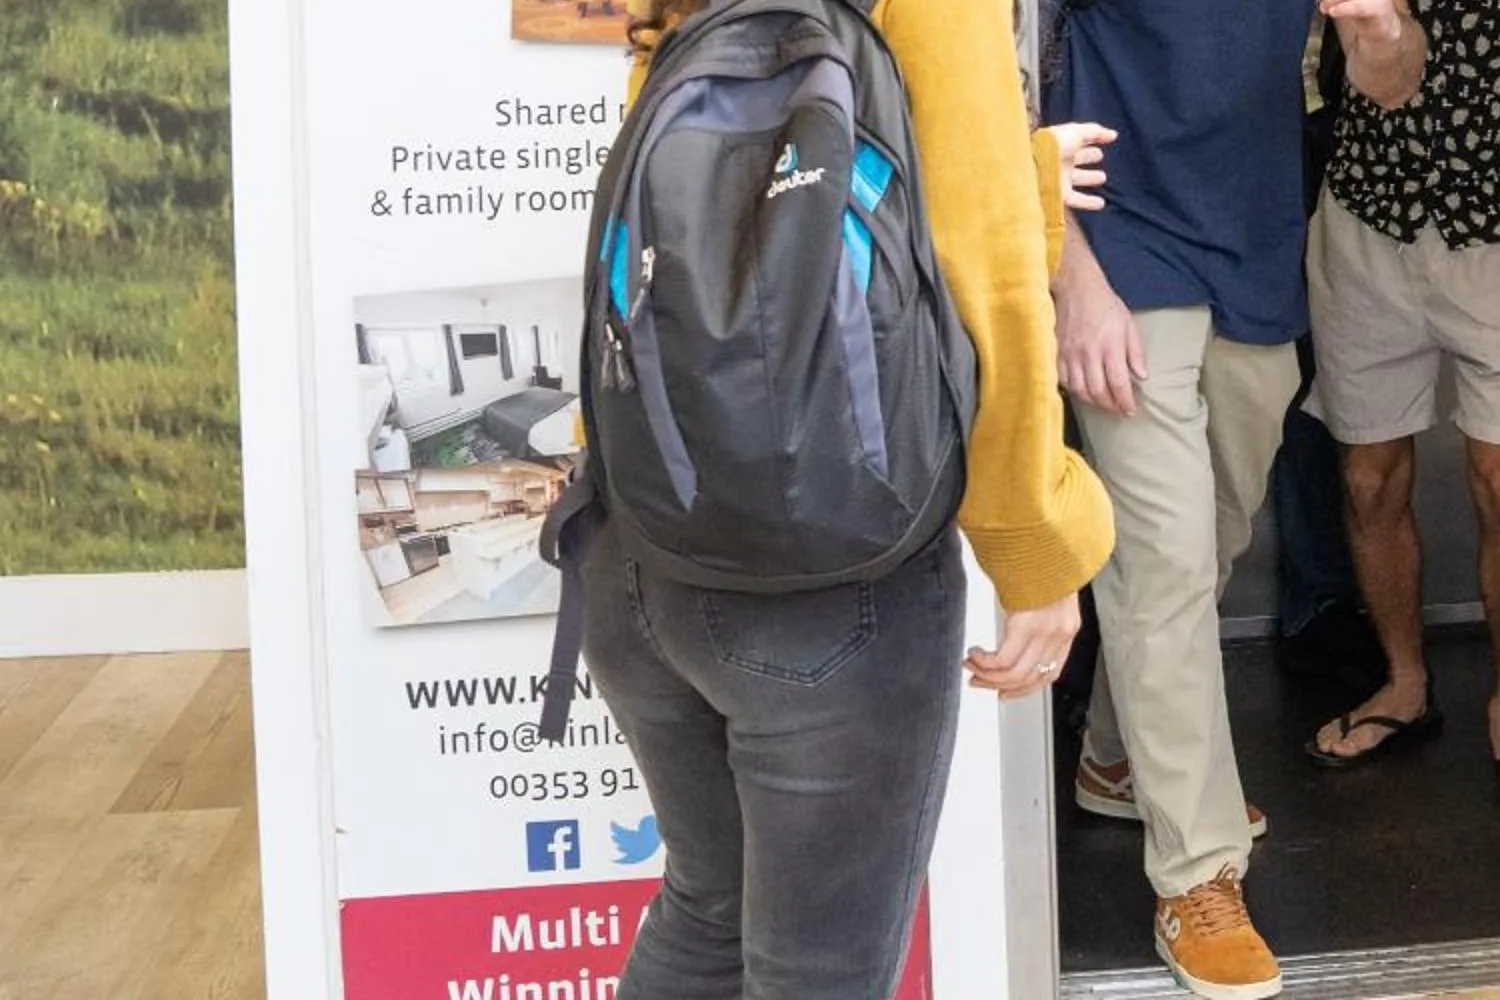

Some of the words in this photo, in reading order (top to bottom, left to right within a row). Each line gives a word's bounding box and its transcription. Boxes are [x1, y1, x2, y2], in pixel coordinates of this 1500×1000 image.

[495, 95, 607, 127] Shared
[392, 144, 506, 173] Private
[516, 139, 609, 176] single
[371, 190, 392, 216] &
[402, 185, 504, 221] family
[439, 715, 626, 755] info@inl
[489, 770, 590, 801] 00353
[600, 766, 640, 798] 91
[491, 904, 621, 954] Multi
